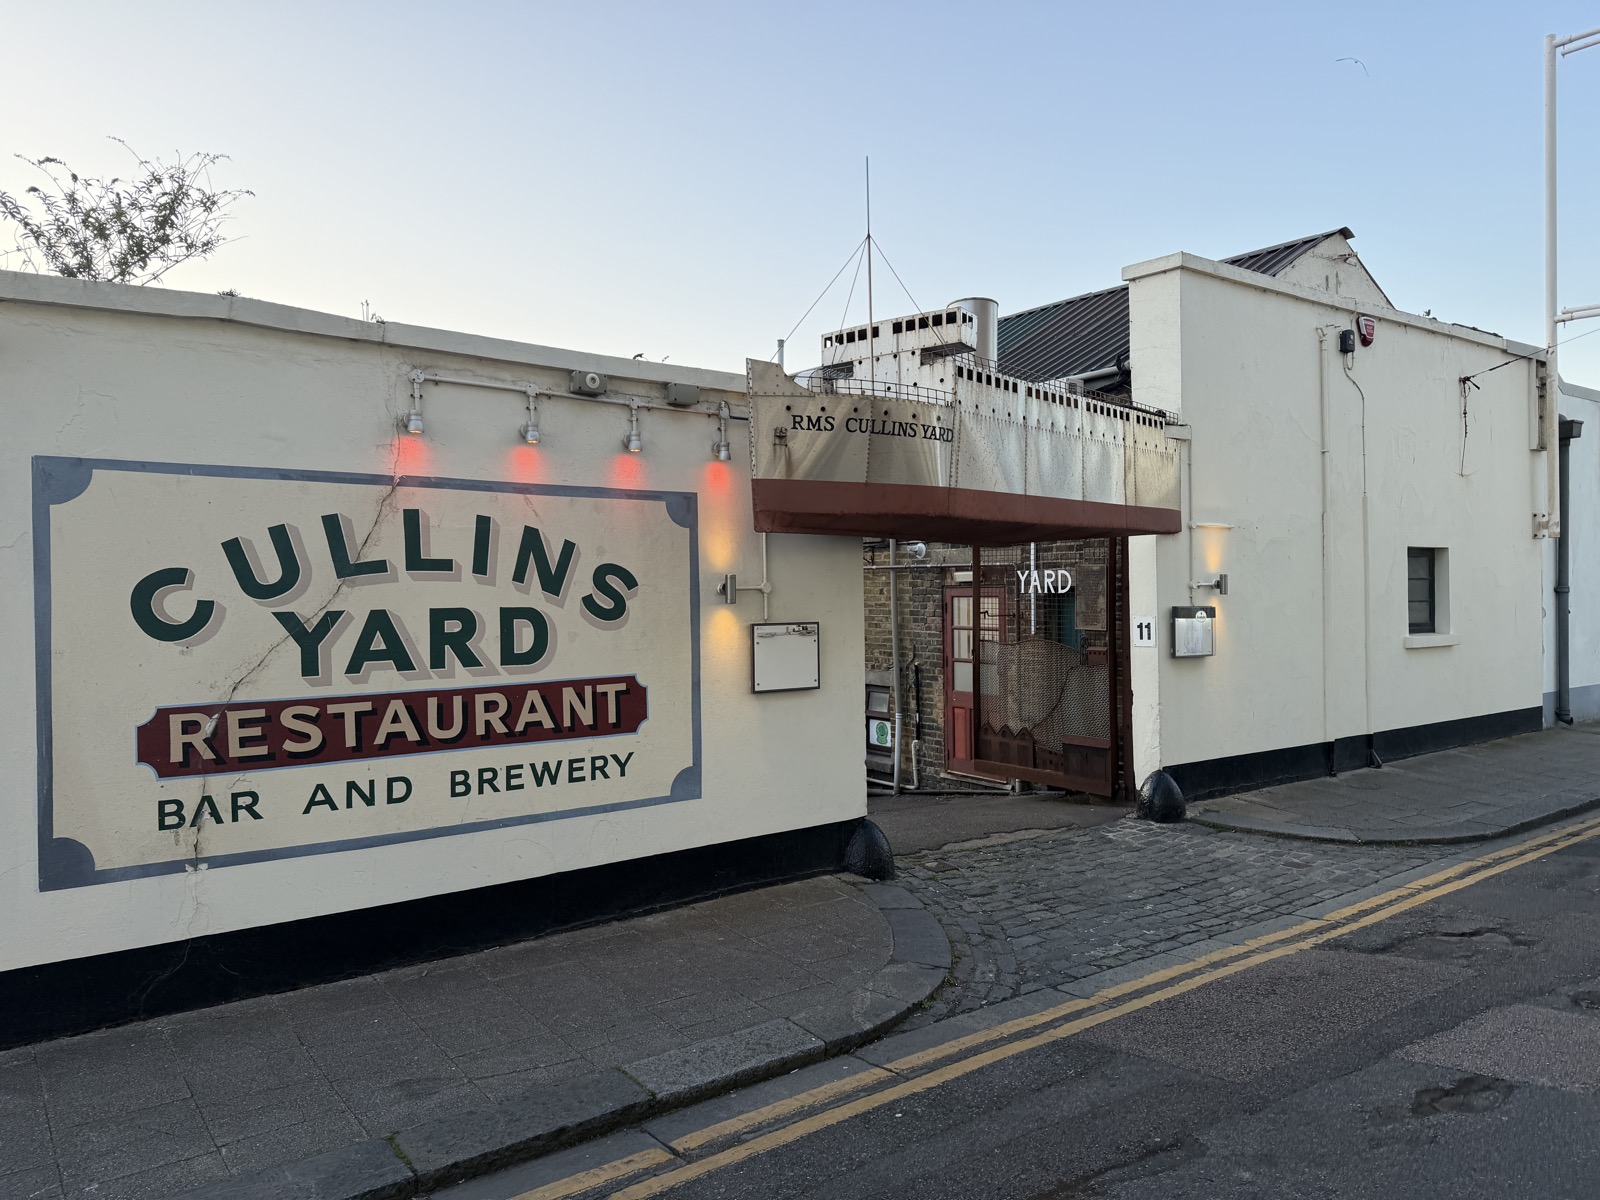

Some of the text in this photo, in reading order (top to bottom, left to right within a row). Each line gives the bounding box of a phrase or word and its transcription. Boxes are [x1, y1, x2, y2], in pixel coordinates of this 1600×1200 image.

[790, 414, 954, 443] RMS CULLINS YARD
[130, 508, 639, 643] CULLINS
[1016, 569, 1072, 594] YARD
[271, 606, 549, 678] YARD
[1136, 622, 1151, 641] 11
[168, 682, 627, 764] RESTAURANT
[157, 751, 635, 832] BAR AND BREWERY
